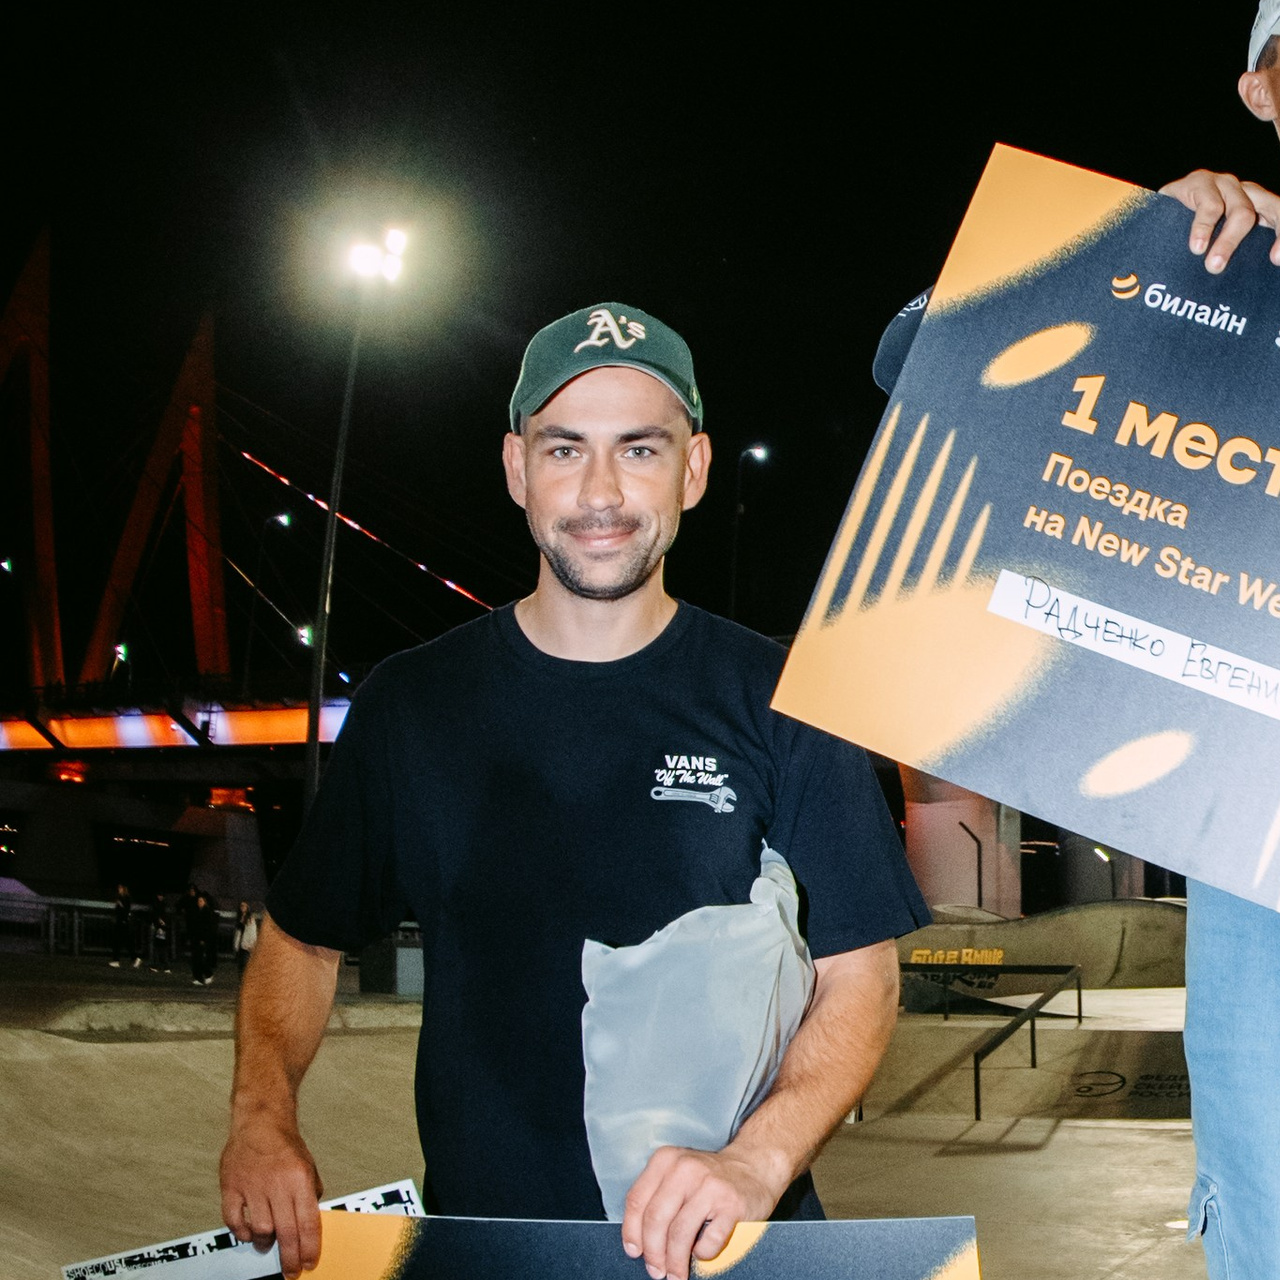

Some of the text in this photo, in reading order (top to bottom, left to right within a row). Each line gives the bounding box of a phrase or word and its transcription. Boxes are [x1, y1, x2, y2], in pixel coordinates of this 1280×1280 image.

[573, 308, 646, 353] A's
[1144, 284, 1247, 335] билайн
[1061, 375, 1105, 435] 1
[1042, 452, 1189, 529] Поездка
[1023, 505, 1066, 539] на
[1072, 515, 1149, 567] New
[1154, 546, 1230, 596] Star
[664, 754, 717, 772] VANS
[675, 769, 696, 784] The
